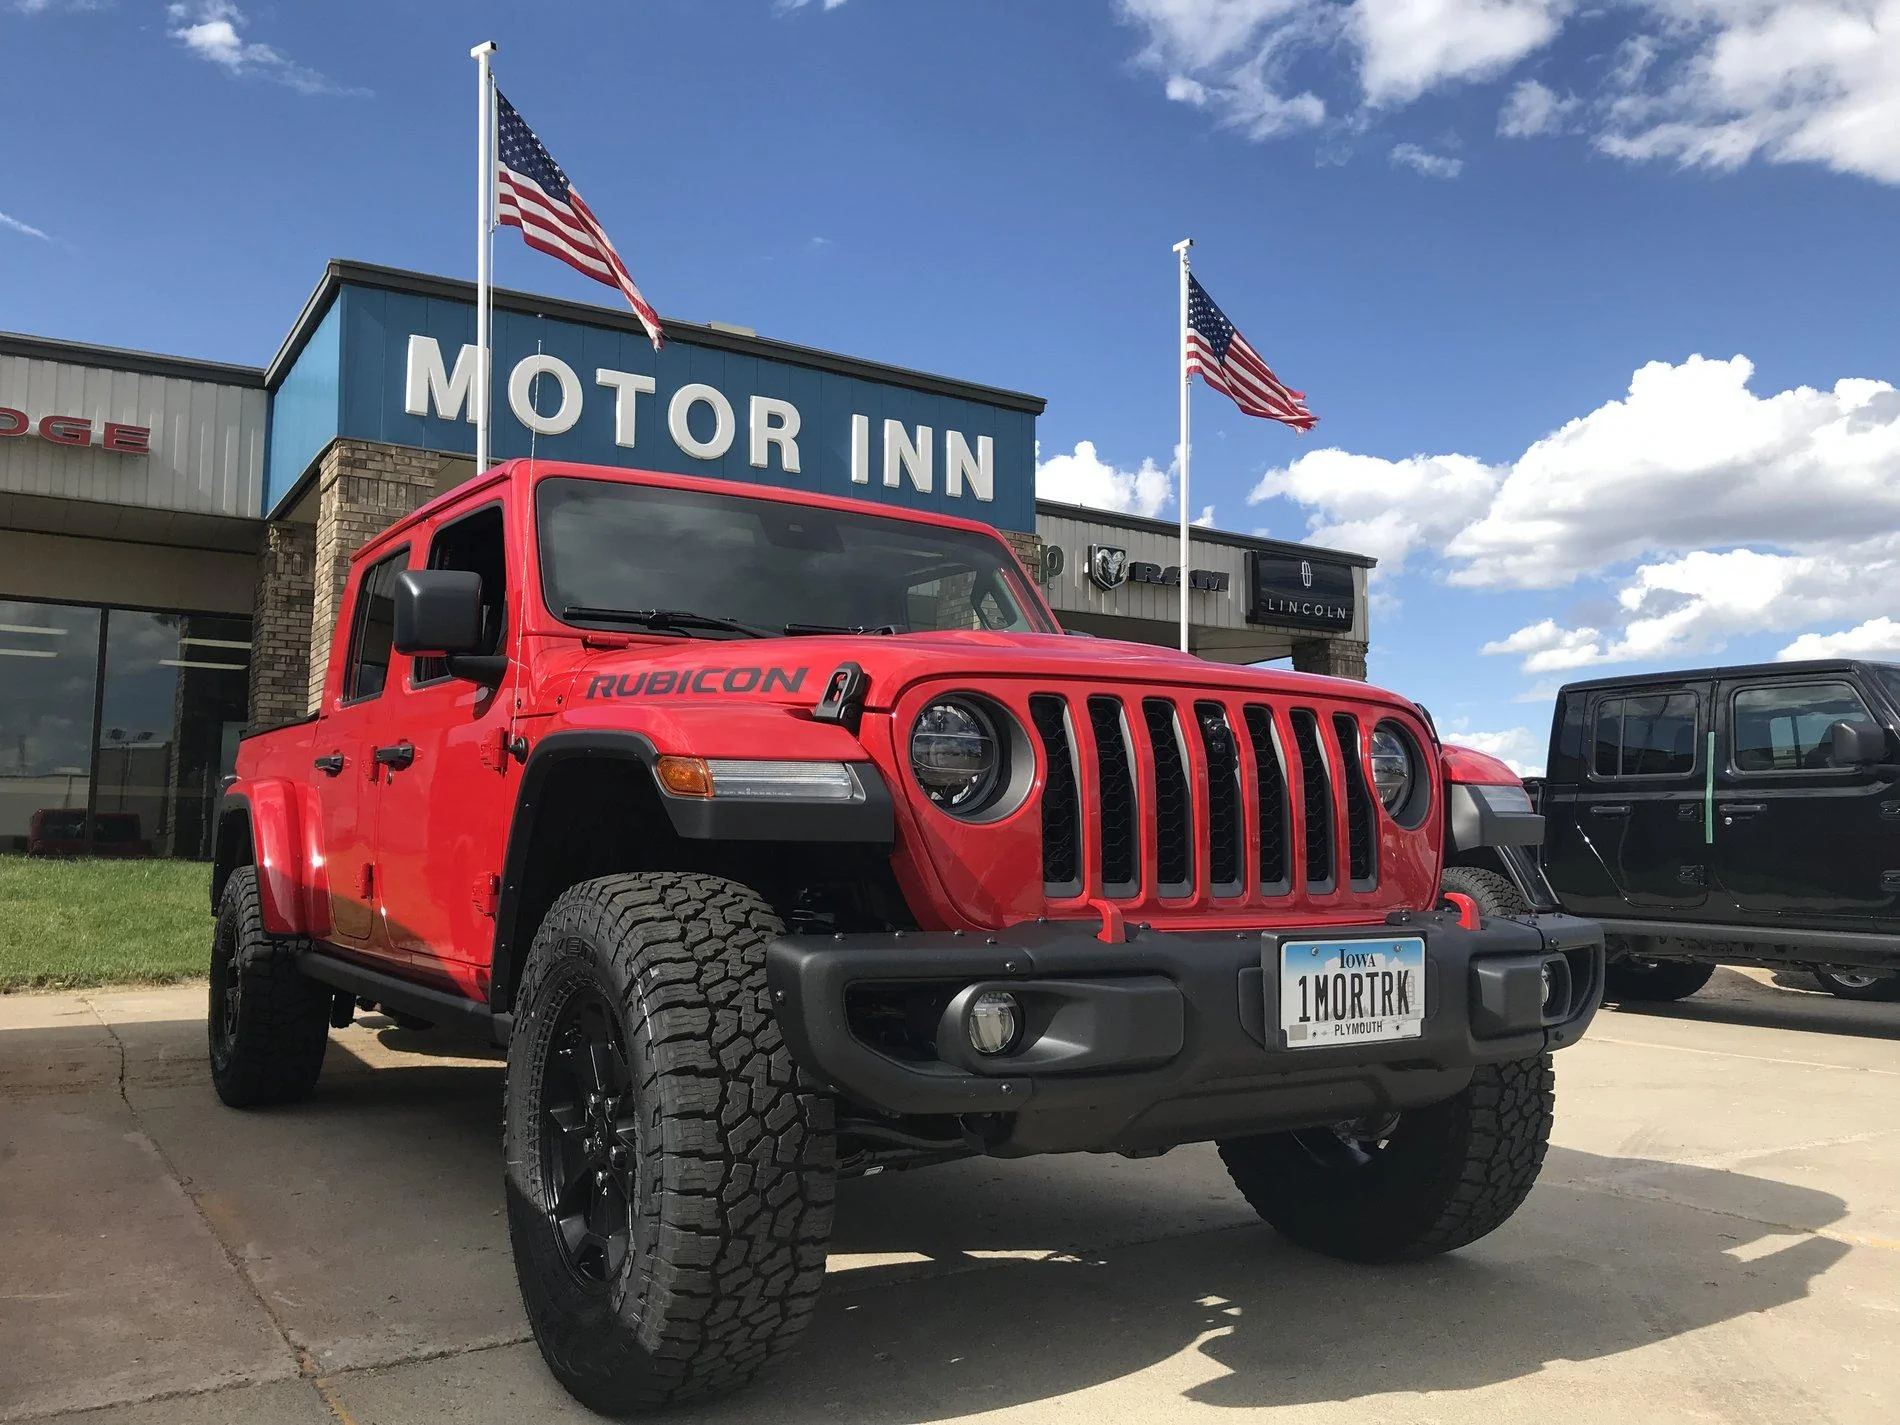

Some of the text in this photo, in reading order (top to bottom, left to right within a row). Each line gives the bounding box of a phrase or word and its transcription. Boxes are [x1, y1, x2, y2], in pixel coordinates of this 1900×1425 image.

[405, 334, 994, 502] MOTOR INN
[1130, 561, 1230, 592] RAM
[1268, 598, 1346, 619] LINCOLN
[586, 666, 809, 700] RUBICON
[1298, 969, 1411, 1023] 1MORTRK
[1333, 1020, 1384, 1037] PLYMOUTH
